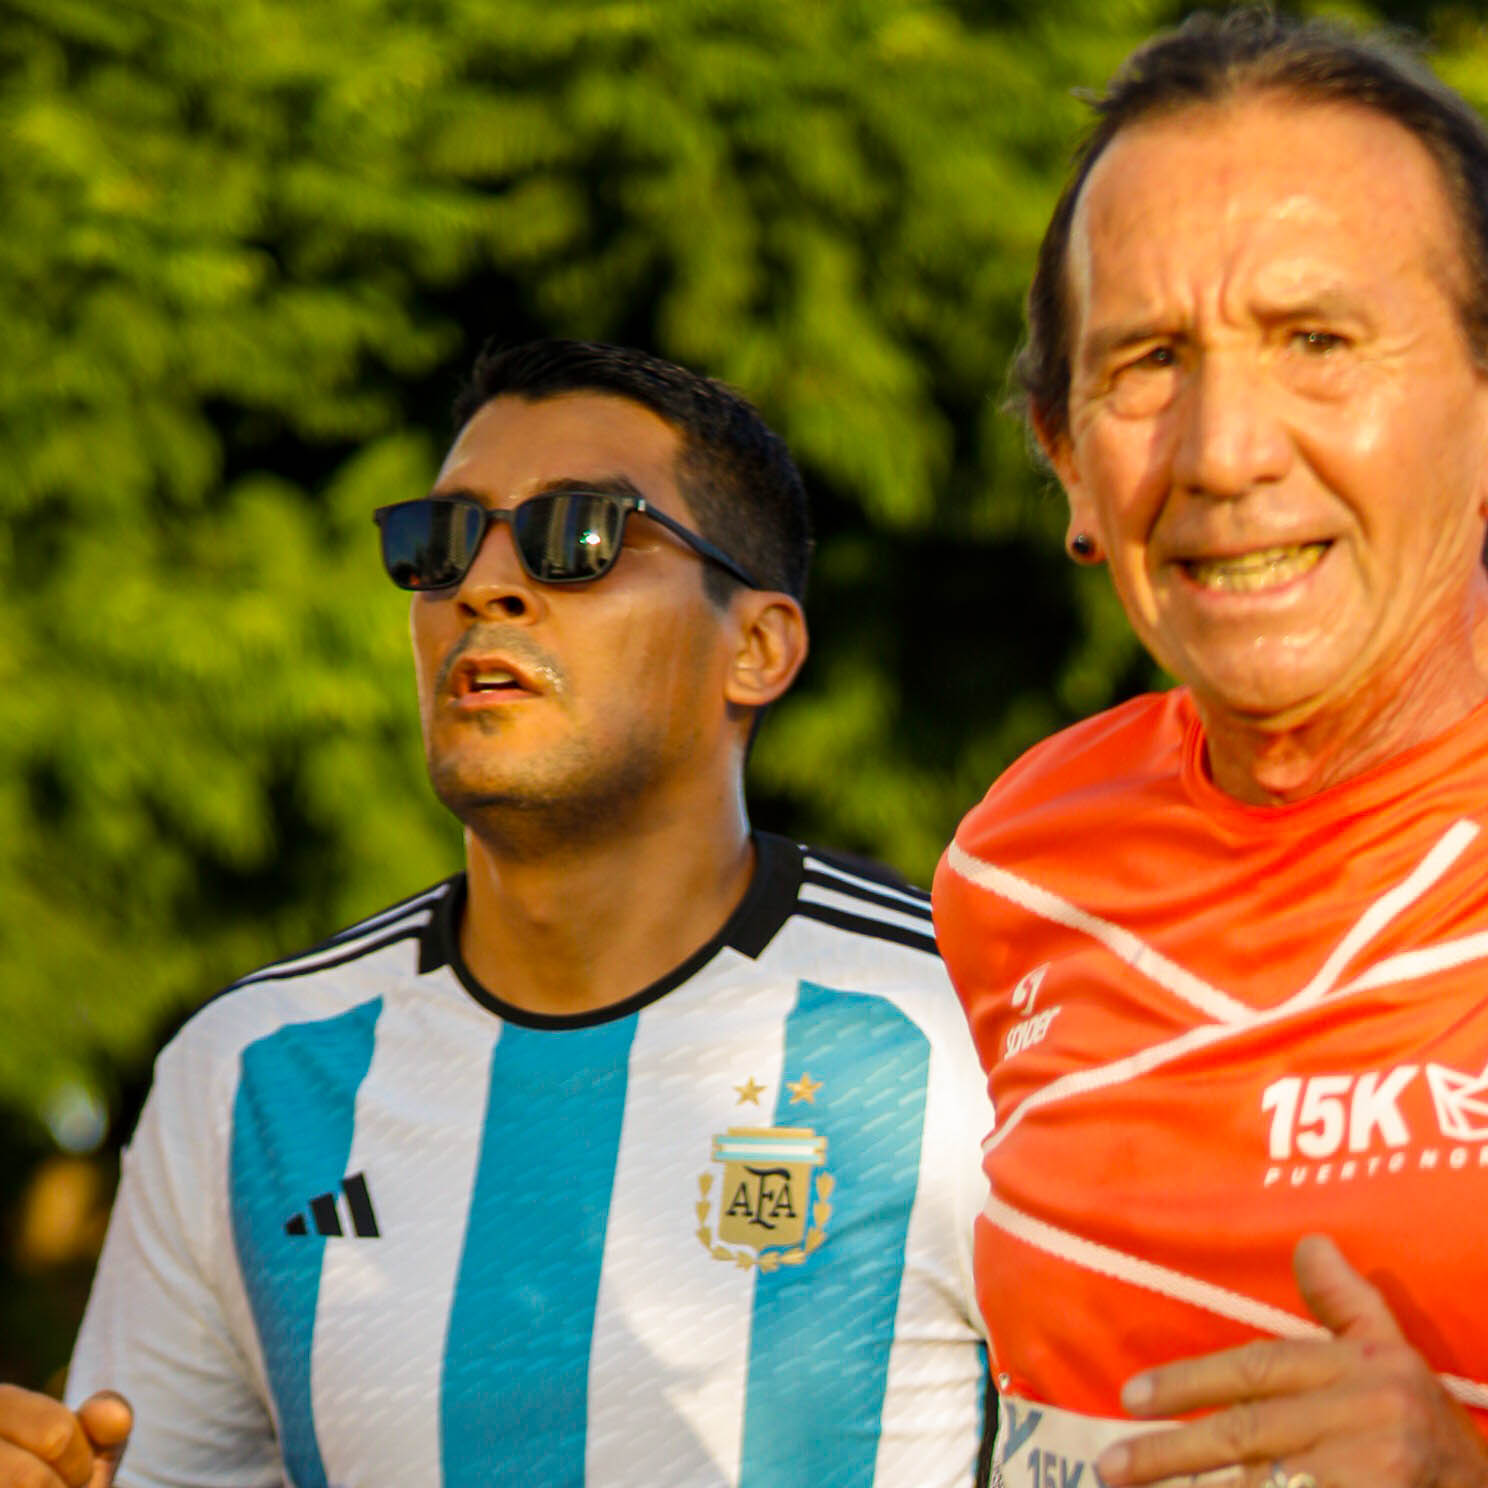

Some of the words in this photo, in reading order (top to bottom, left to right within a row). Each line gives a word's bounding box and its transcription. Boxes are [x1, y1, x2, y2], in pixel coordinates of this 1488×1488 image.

[1260, 1063, 1425, 1162] 15K
[725, 1165, 797, 1230] AFA
[1263, 1150, 1406, 1188] PUERTO
